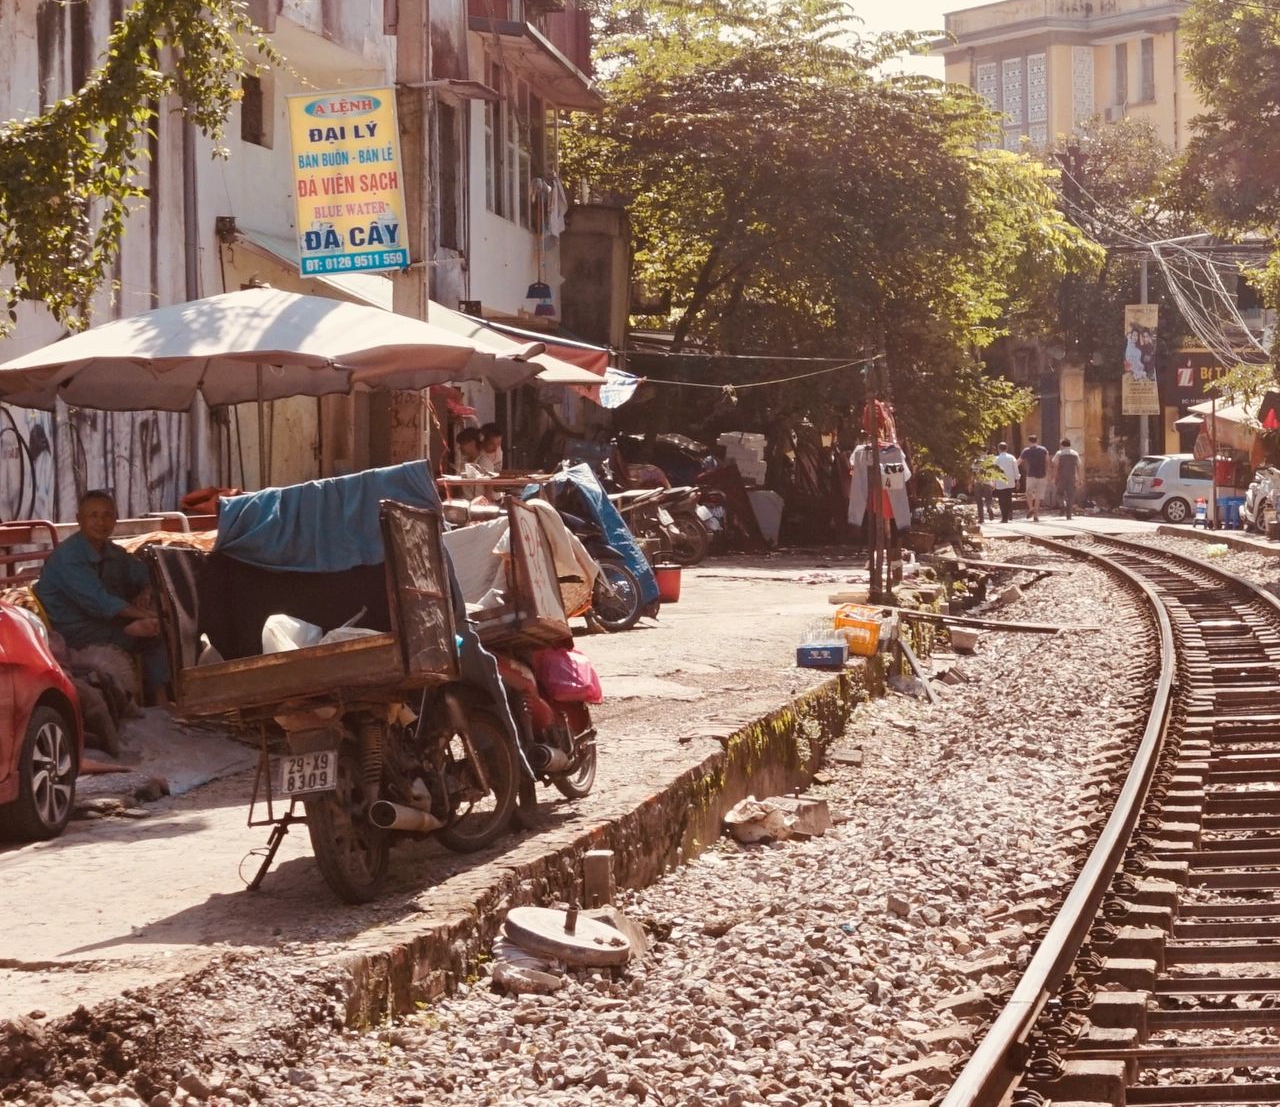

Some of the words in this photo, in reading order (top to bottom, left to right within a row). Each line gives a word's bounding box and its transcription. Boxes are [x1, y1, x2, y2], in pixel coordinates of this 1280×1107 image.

[314, 105, 325, 115] A
[331, 99, 373, 115] LỆNH
[309, 124, 346, 144] ĐẠI
[353, 121, 378, 140] LÝ
[298, 151, 318, 169] BÁN
[322, 149, 349, 168] BUÔN
[359, 146, 379, 164] BÁN
[298, 175, 318, 198] ĐÁ
[322, 173, 355, 194] VIÊN
[360, 171, 398, 196] SẠCH
[314, 204, 343, 219] BLUE
[345, 201, 387, 217] WATER
[305, 225, 340, 251] ĐÁ
[349, 221, 399, 248] CÂY
[287, 771, 328, 791] 8309
